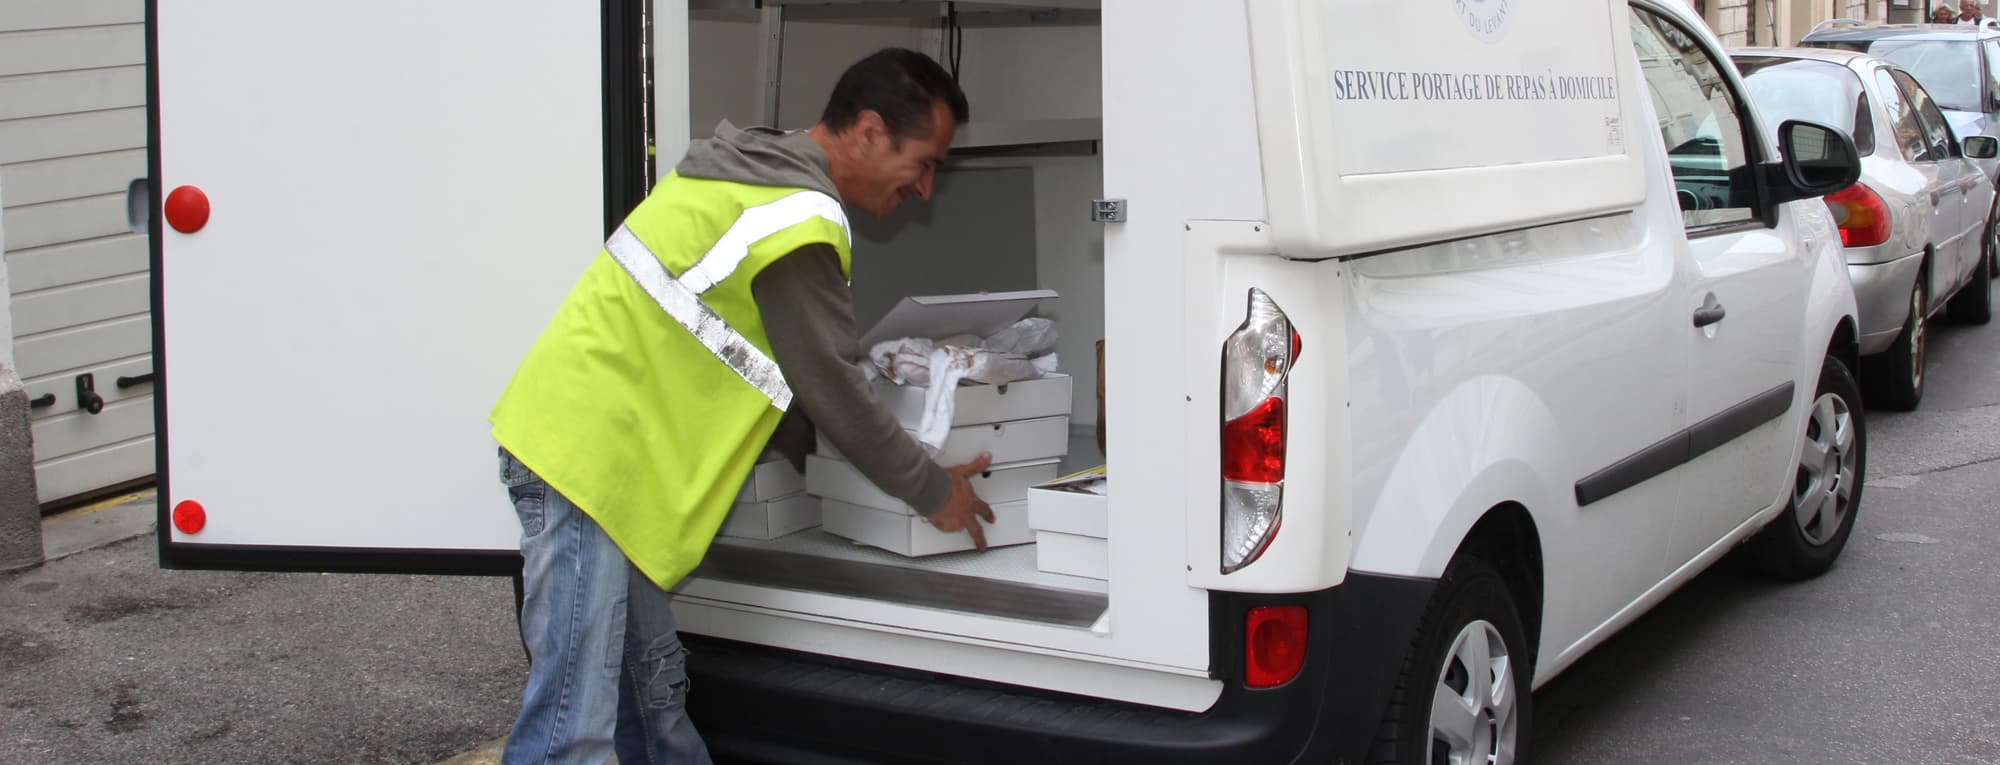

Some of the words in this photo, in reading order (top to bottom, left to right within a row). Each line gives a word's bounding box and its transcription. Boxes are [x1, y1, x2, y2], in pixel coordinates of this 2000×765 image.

[1469, 12, 1481, 32] DU
[1334, 69, 1409, 101] SERVICE
[1411, 72, 1482, 101] PORTAGE
[1484, 73, 1504, 101] DE
[1505, 74, 1546, 101] REPAS
[1548, 67, 1558, 101] À
[1558, 75, 1616, 101] DOMICILE
